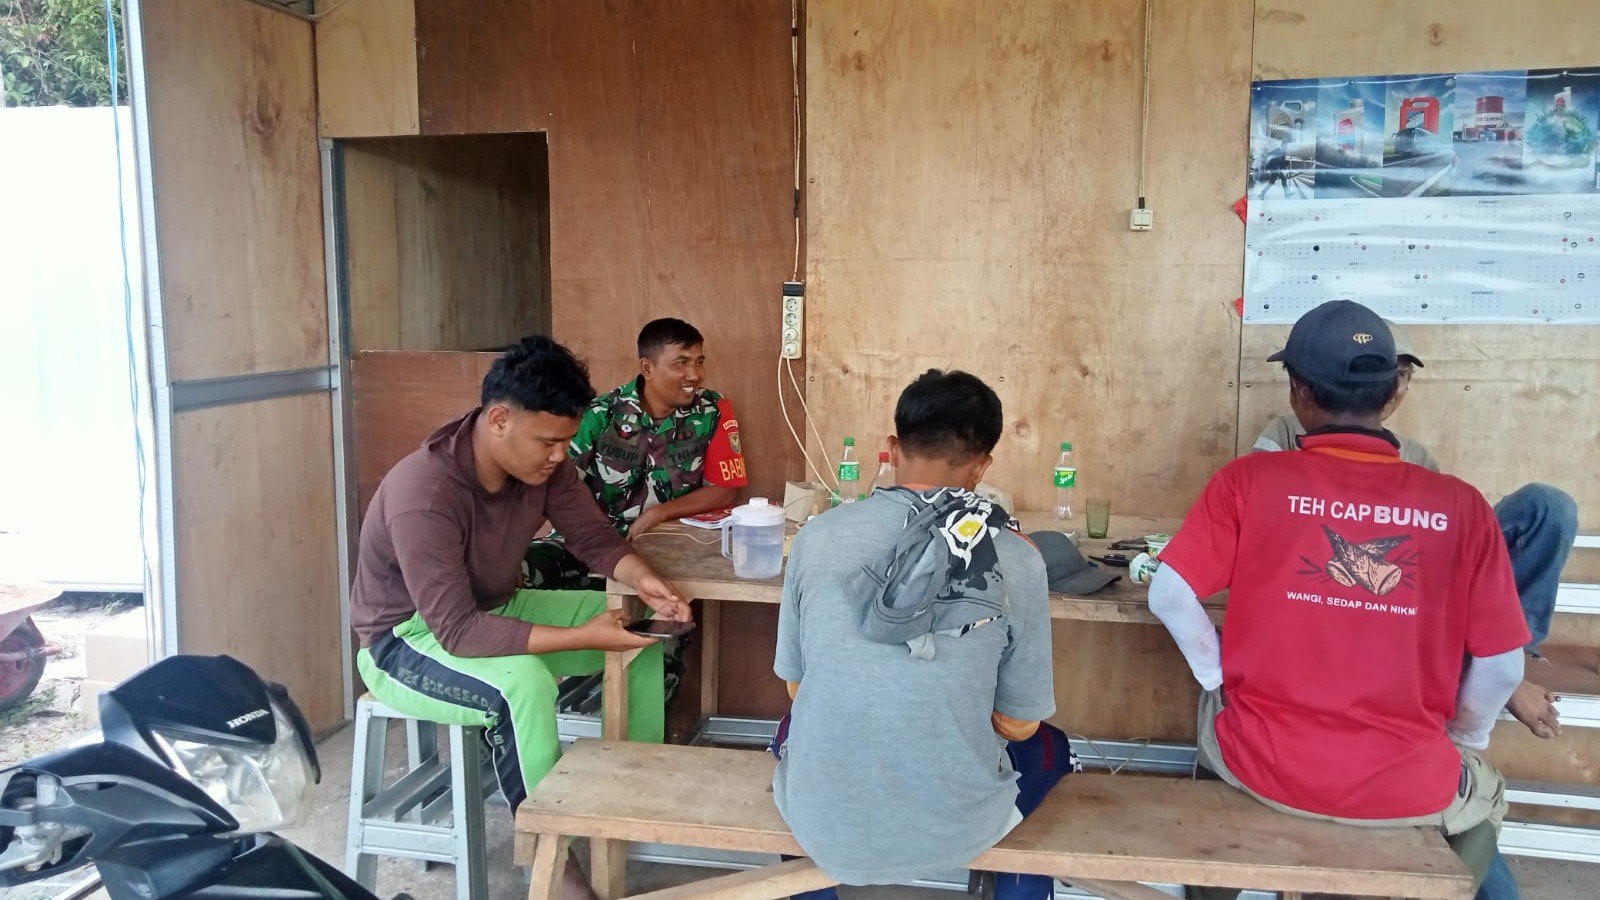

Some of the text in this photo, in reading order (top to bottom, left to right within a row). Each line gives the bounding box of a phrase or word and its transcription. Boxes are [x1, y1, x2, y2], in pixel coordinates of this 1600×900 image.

[1288, 495, 1325, 516] TEH
[1286, 591, 1418, 616] WANGI, SEDAP DAN NIKM
[226, 709, 270, 729] HONDA
